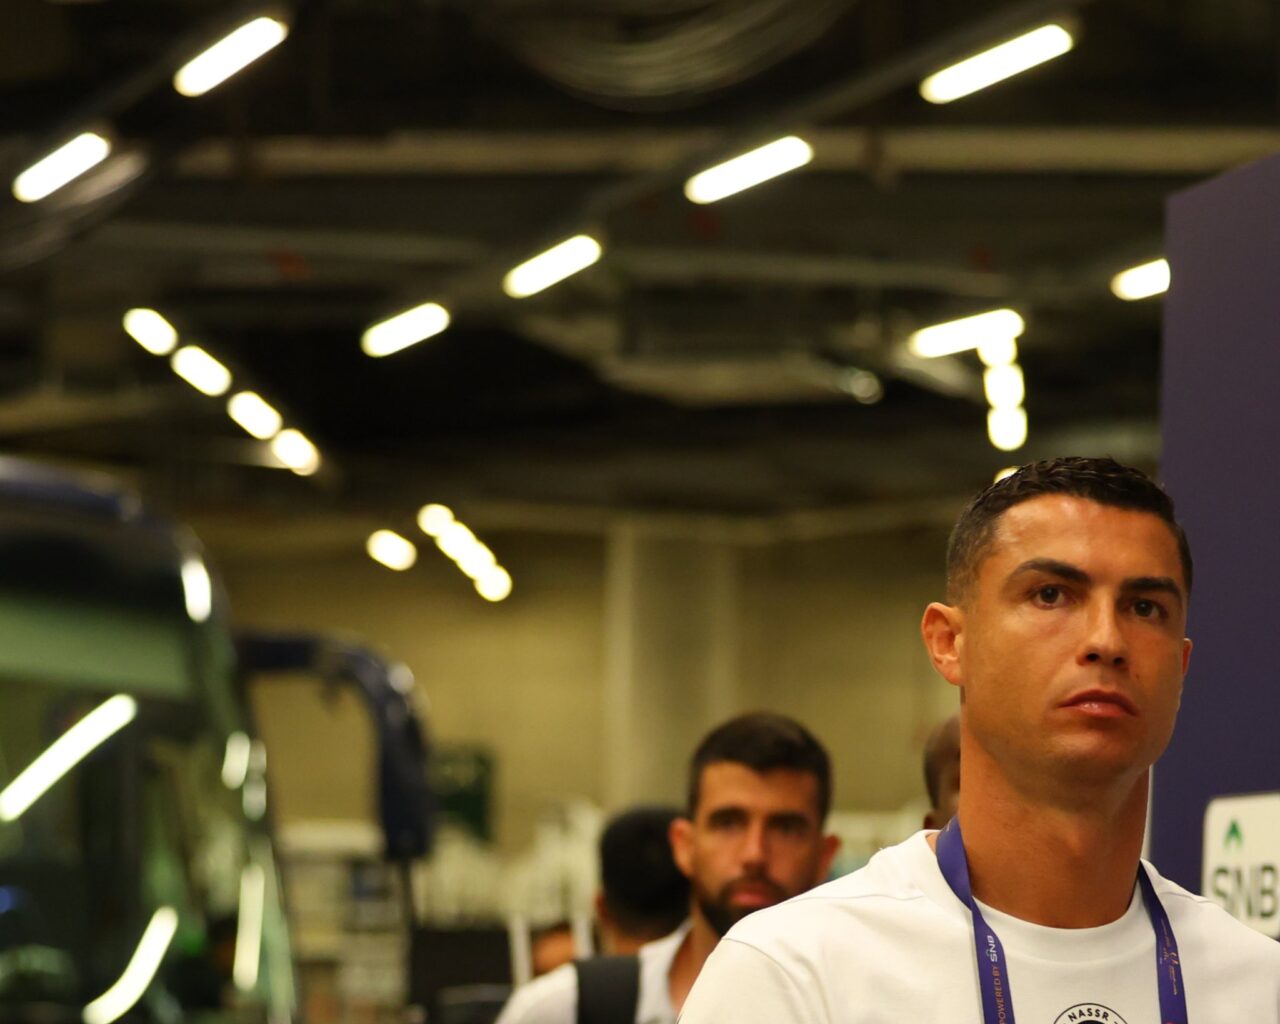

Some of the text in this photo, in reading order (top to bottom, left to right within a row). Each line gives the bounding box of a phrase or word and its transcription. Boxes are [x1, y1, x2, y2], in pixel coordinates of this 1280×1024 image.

[1212, 863, 1279, 919] SNB
[987, 935, 998, 962] SNB
[993, 977, 1007, 1024] POWERED
[1068, 1008, 1109, 1021] NASSR
